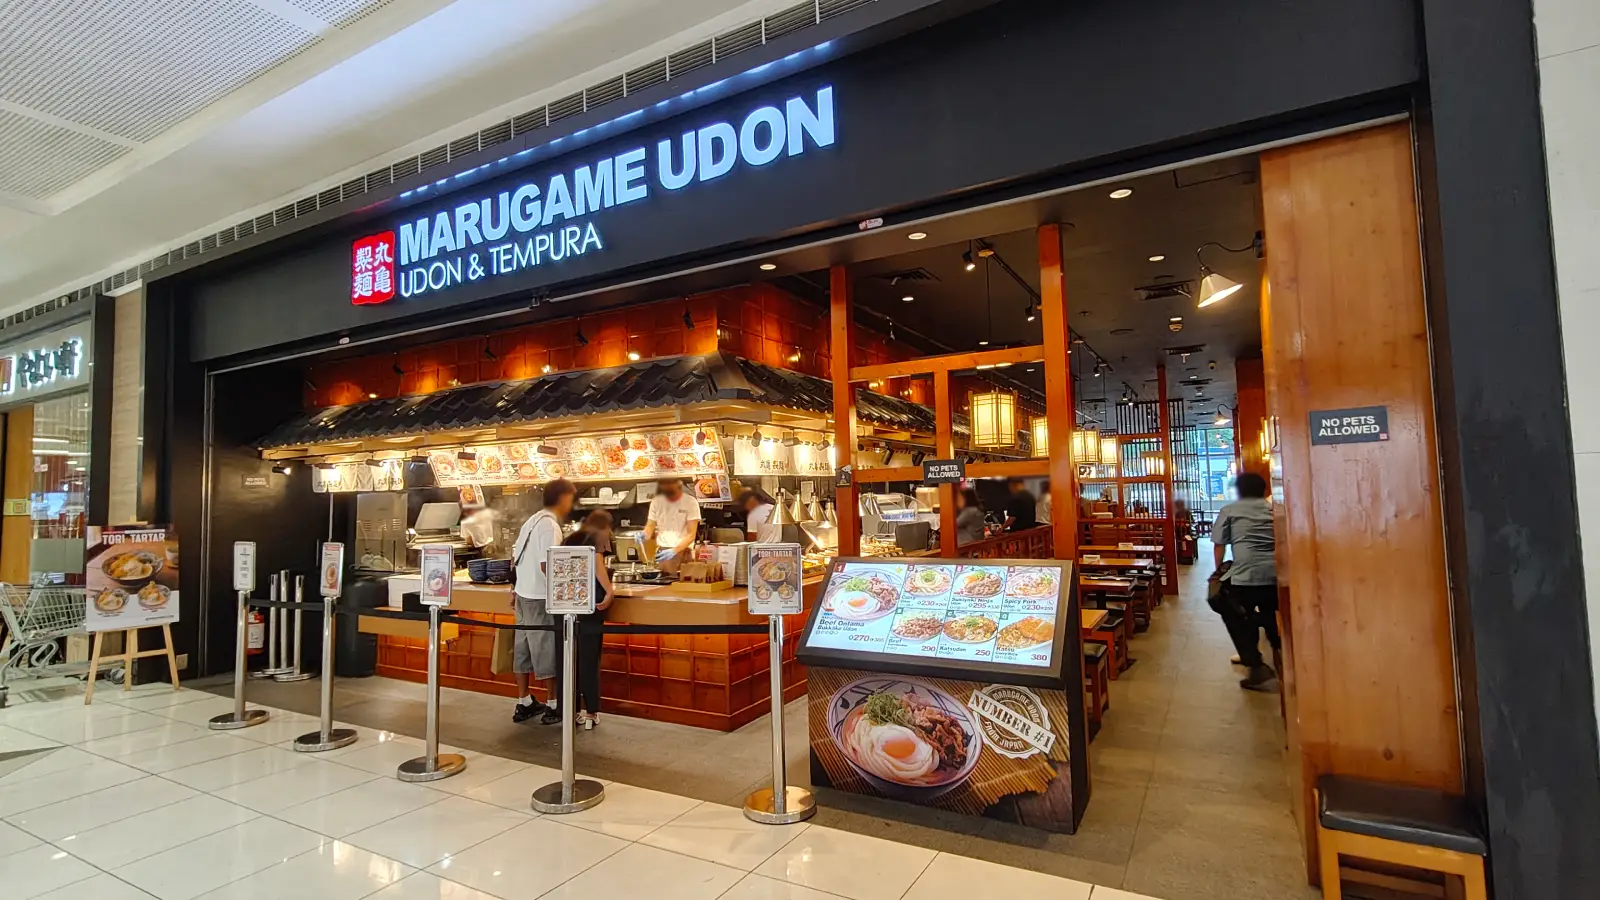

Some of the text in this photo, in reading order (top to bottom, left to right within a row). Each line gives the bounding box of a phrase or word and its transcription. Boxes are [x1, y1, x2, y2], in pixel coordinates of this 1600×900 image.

[400, 85, 836, 266] MARUGAME UDON
[400, 221, 603, 298] UDON & TEMPURA
[1321, 415, 1375, 428] NO PETS
[1318, 424, 1380, 437] ALLOWED
[927, 471, 961, 479] ALLOWED
[102, 532, 166, 545] TORI TARTAR
[853, 634, 870, 642] 270
[1030, 653, 1048, 661] 380
[971, 694, 1052, 749] NUMBER #1
